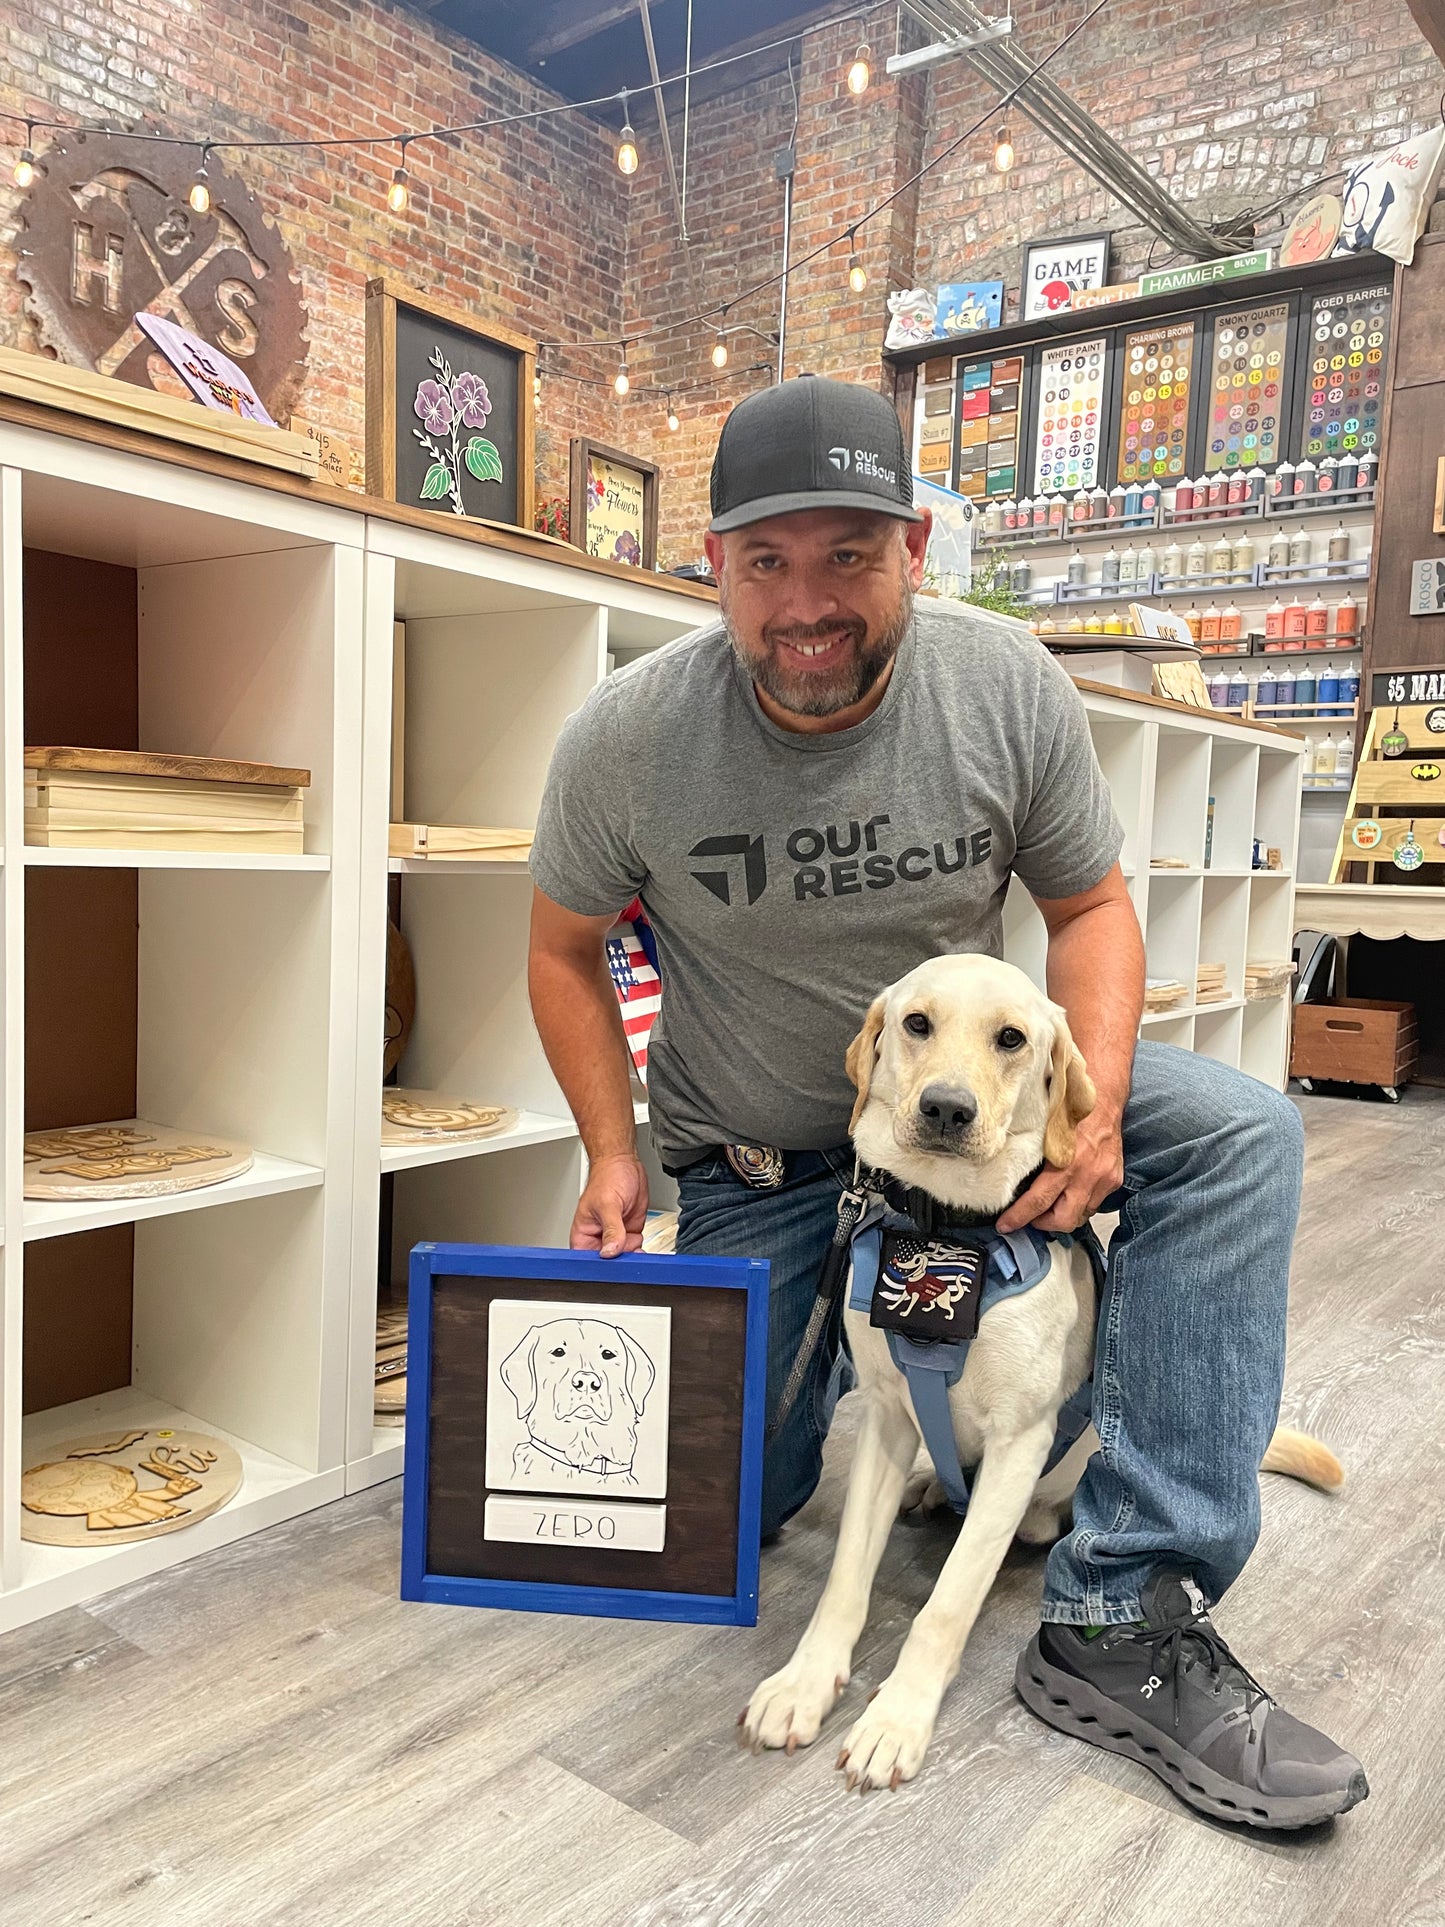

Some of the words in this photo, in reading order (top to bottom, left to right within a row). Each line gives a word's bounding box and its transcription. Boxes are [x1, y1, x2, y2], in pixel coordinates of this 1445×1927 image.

[1376, 147, 1419, 169] Jack
[1035, 256, 1098, 280] GAME
[1150, 264, 1225, 292] HAMMER
[1233, 256, 1258, 269] BLVD
[1314, 296, 1344, 310] AGED
[1346, 286, 1391, 303] BARREL
[1219, 314, 1249, 327] SMOKY
[1251, 306, 1287, 321] QUARTZ
[1130, 331, 1166, 345] CHARMING
[1167, 325, 1194, 338] BROWN
[1048, 348, 1073, 360] WHITE
[1076, 342, 1101, 354] PAINT
[307, 427, 329, 449] $45
[923, 428, 939, 440] Stain
[940, 428, 949, 437] #7
[323, 460, 342, 474] Glass
[329, 452, 341, 465] for
[921, 456, 938, 467] Stain
[939, 454, 947, 464] #9
[856, 461, 896, 484] RESCUE
[606, 489, 639, 517] Flowers
[1419, 562, 1433, 610] ROSCO
[1388, 676, 1405, 702] $5
[794, 827, 993, 900] RESCUE
[533, 1512, 616, 1540] ZERO
